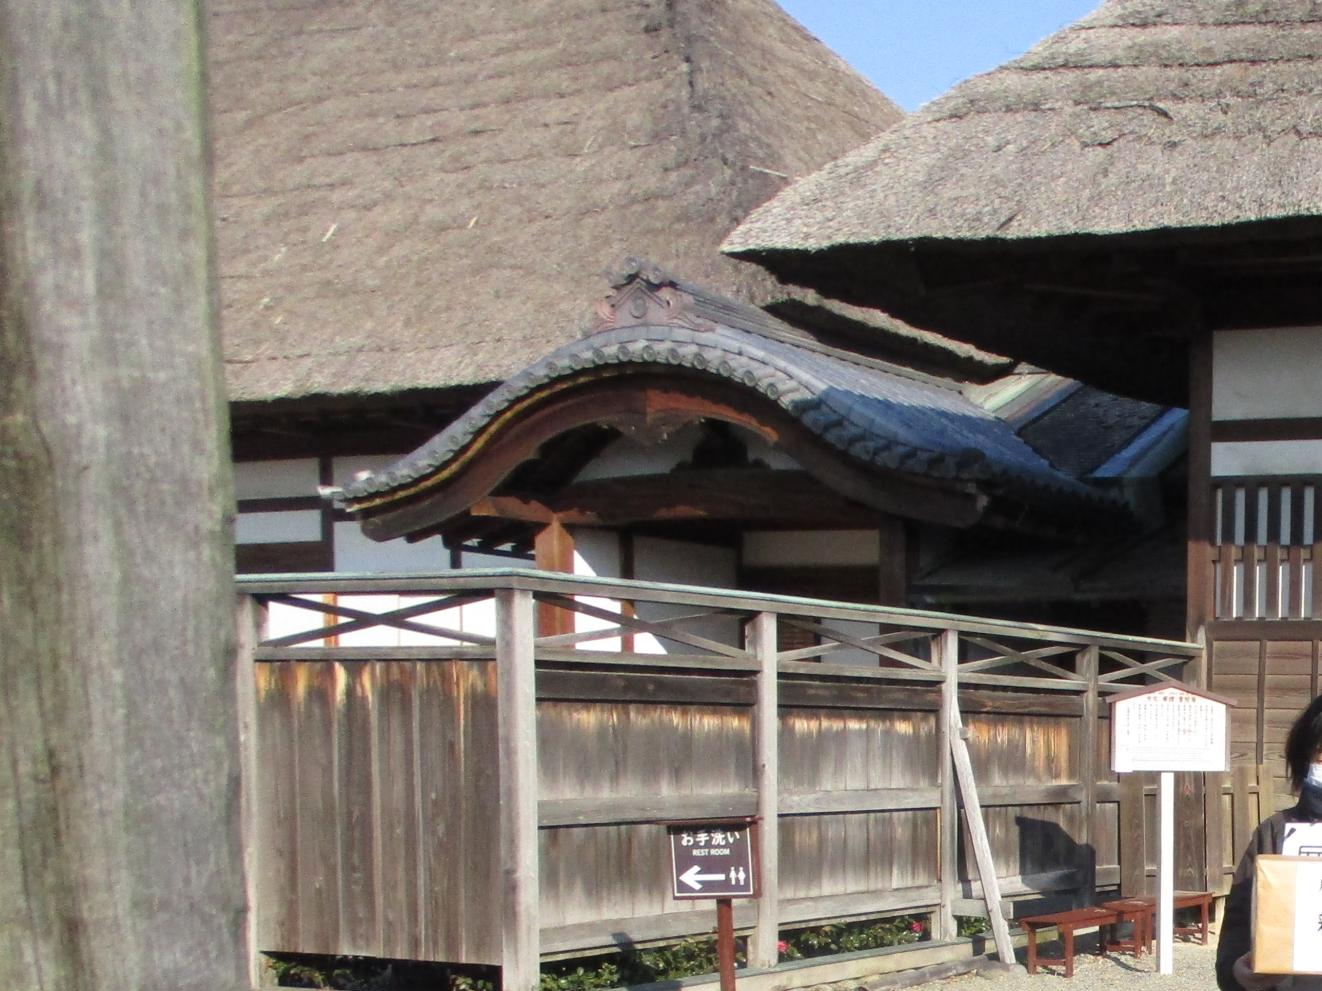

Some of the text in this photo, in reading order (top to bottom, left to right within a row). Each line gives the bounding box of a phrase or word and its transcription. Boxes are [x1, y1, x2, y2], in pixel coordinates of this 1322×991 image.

[681, 830, 740, 846] お手洗い
[692, 848, 730, 856] REST ROOM
